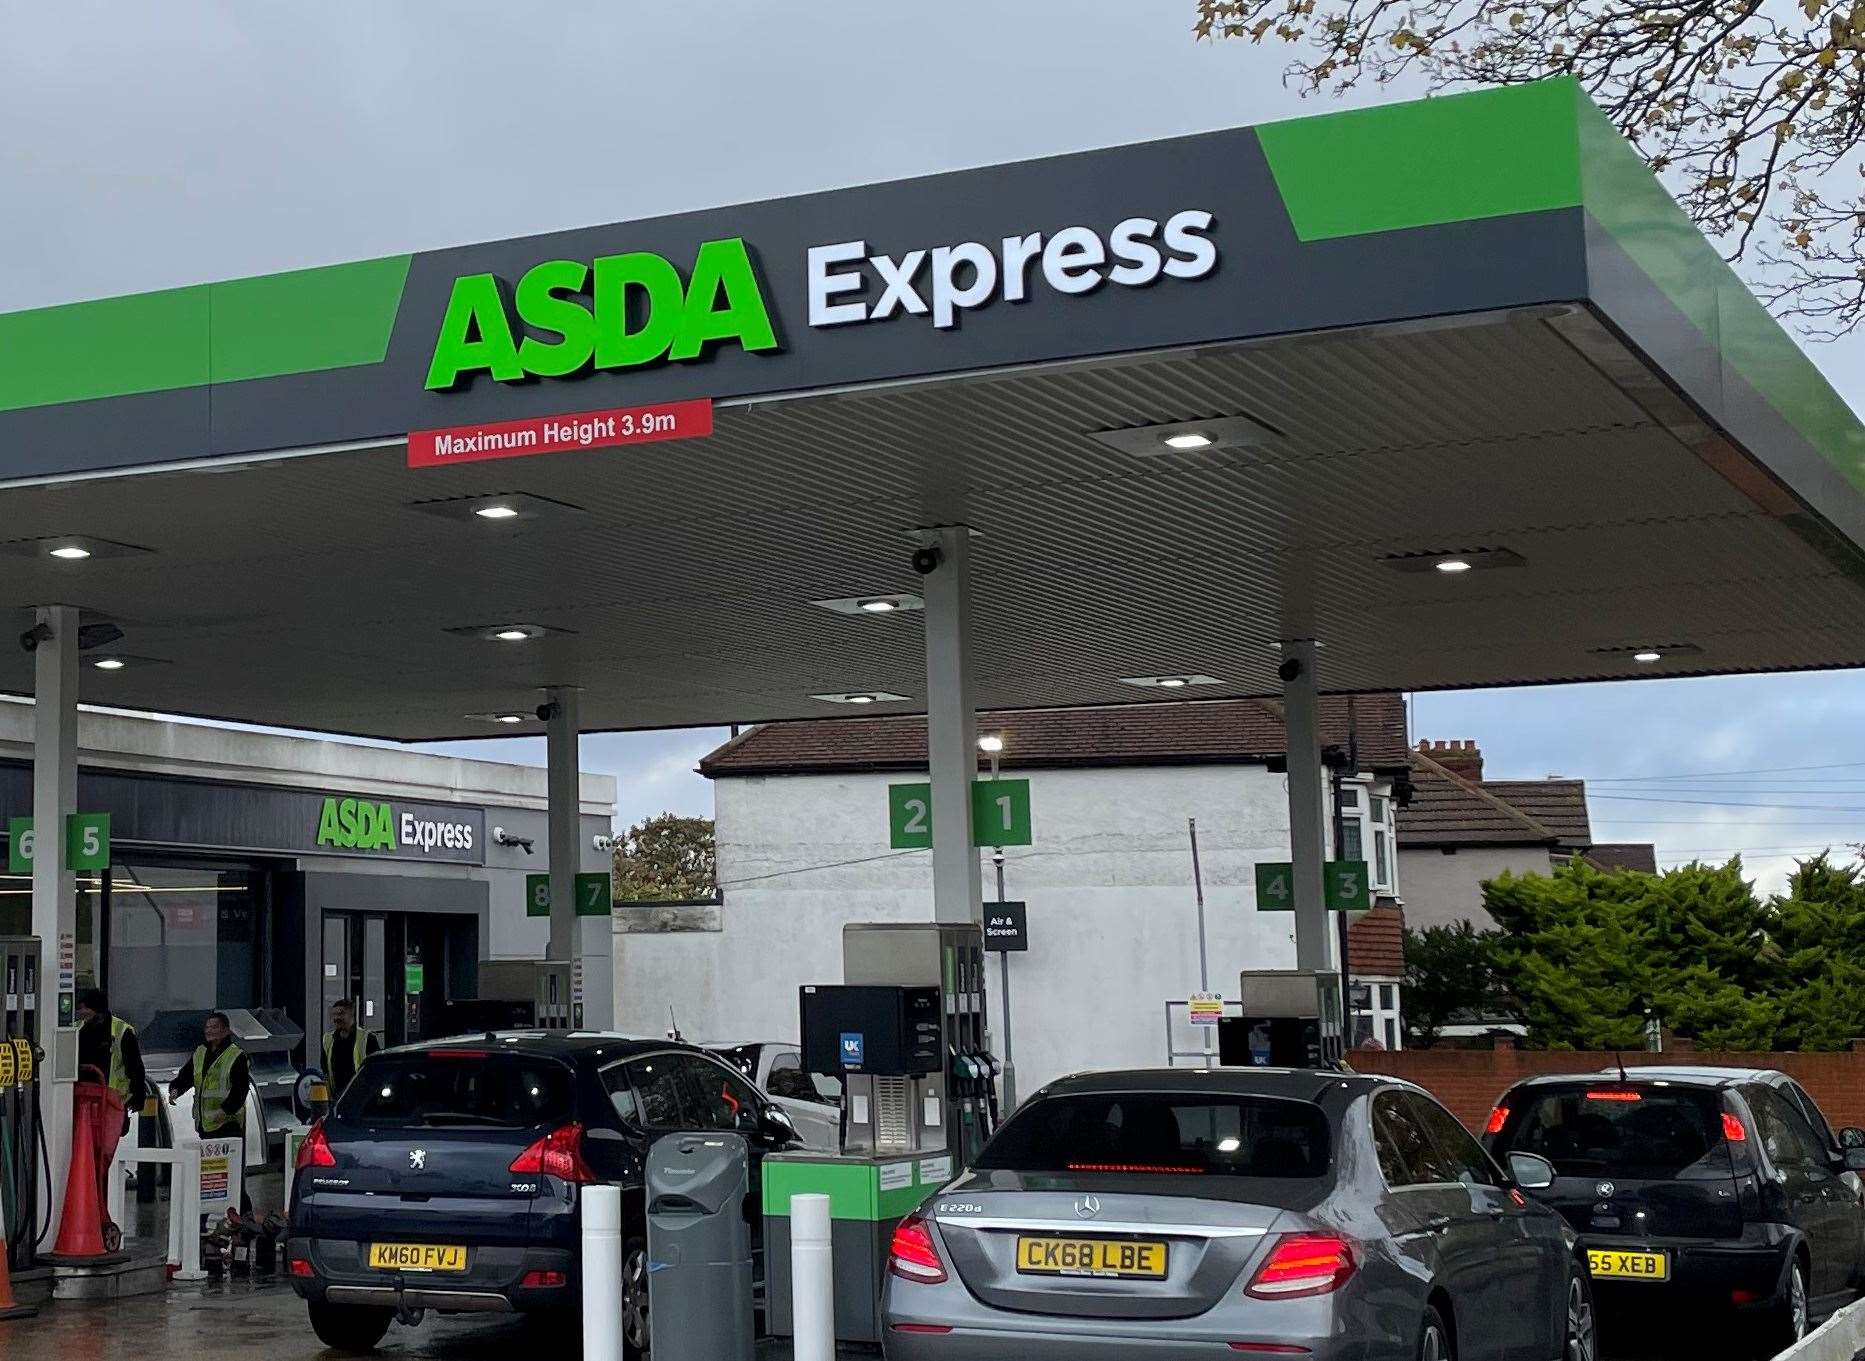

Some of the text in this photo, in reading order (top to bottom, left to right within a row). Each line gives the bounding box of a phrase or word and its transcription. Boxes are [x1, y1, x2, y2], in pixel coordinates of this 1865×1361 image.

[425, 209, 1219, 391] ASDA Express
[434, 412, 676, 456] Maximum Height 3.9m
[317, 796, 473, 852] ASDA Express
[904, 799, 927, 833] 2
[996, 795, 1012, 831] 1
[19, 829, 34, 859] 6
[82, 826, 100, 857] 5
[535, 884, 550, 906] 8
[587, 883, 601, 906] 7
[1266, 875, 1289, 899] 4
[1339, 873, 1358, 899] 3
[986, 928, 1018, 937] Screen
[990, 916, 1013, 926] Air &
[377, 1248, 459, 1266] KM60 FVJ
[1028, 1241, 1154, 1271] CK68 LBE
[1617, 1255, 1656, 1274] XEB
